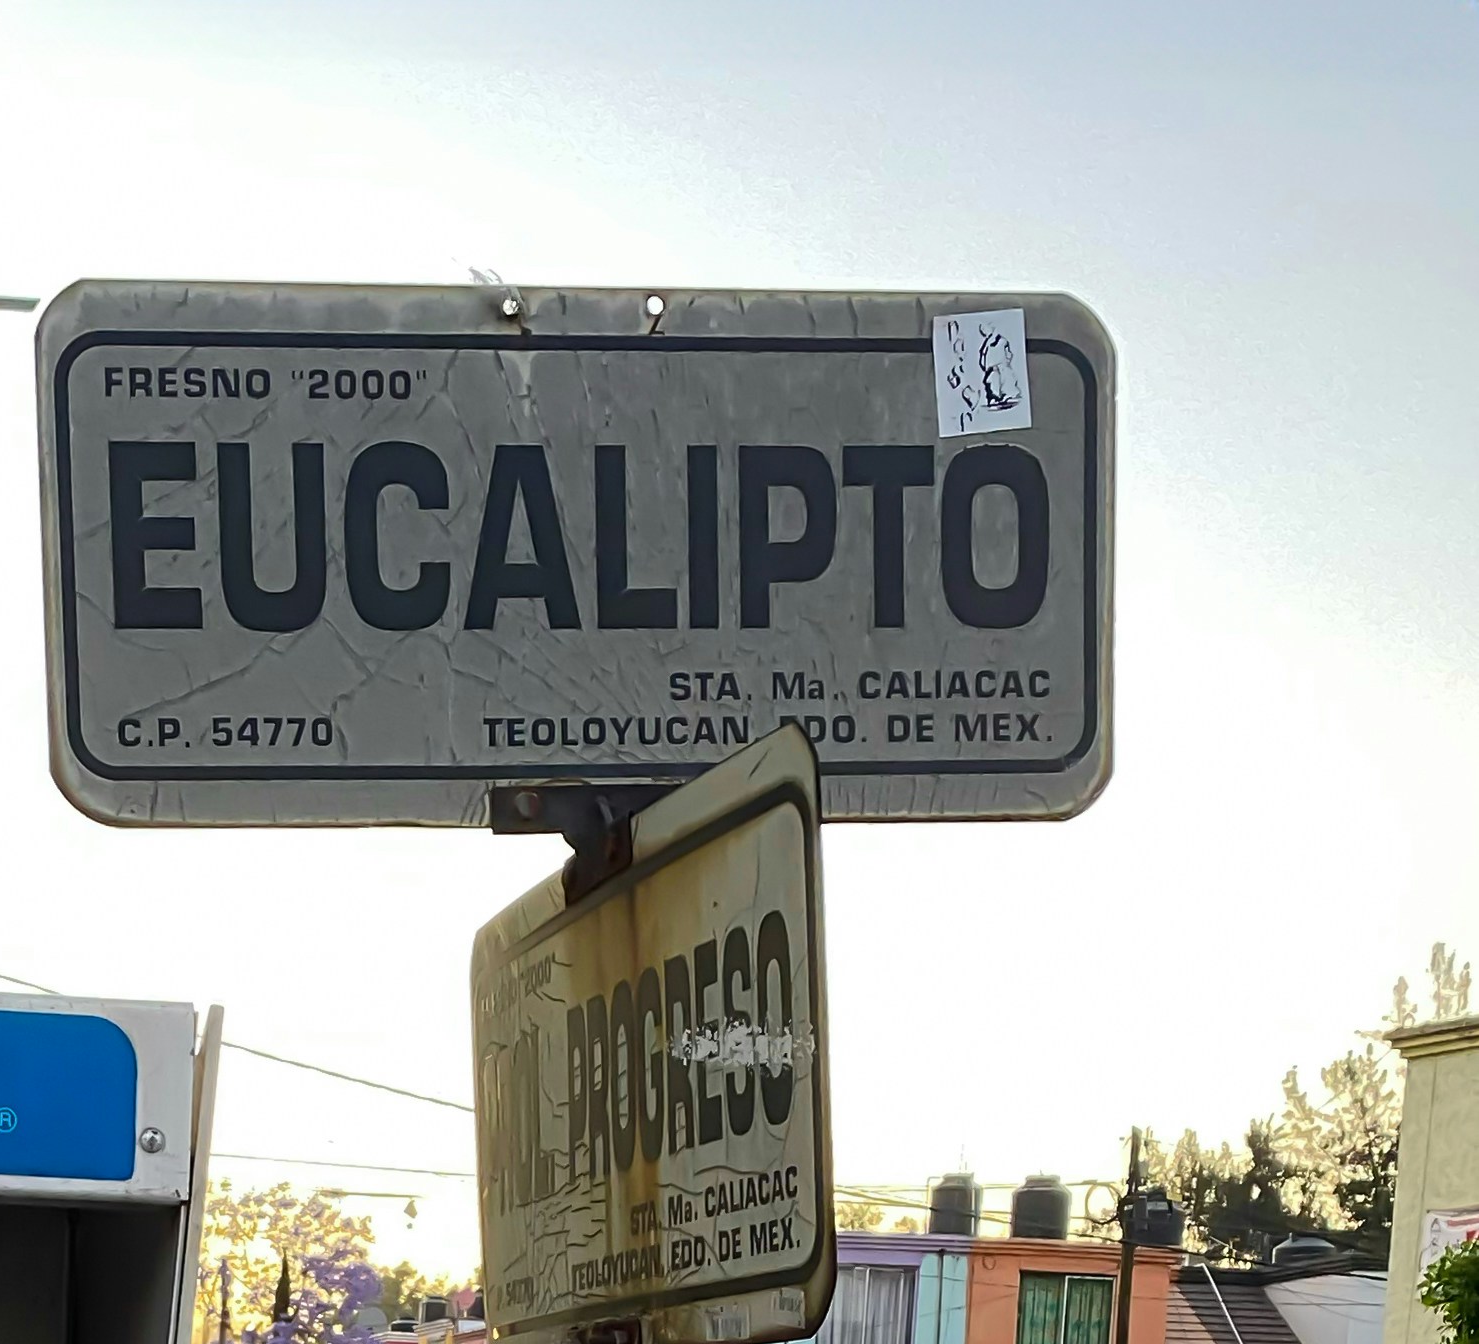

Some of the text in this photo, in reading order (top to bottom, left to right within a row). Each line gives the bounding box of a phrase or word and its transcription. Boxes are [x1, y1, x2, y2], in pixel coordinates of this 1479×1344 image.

[104, 367, 427, 400] FRESNO "2000"
[107, 440, 1052, 632] EUCALIPTO
[669, 669, 1051, 702] STA. Ma. CALIACAC
[118, 717, 333, 748] C.P. 54770
[888, 715, 934, 743] DE
[954, 713, 1053, 742] MEX.
[567, 910, 793, 1184] PROGRESO
[704, 1165, 798, 1218] CALIACAC
[671, 1236, 711, 1272] EDO.
[718, 1227, 742, 1263] DE
[749, 1217, 800, 1257] MEX.
